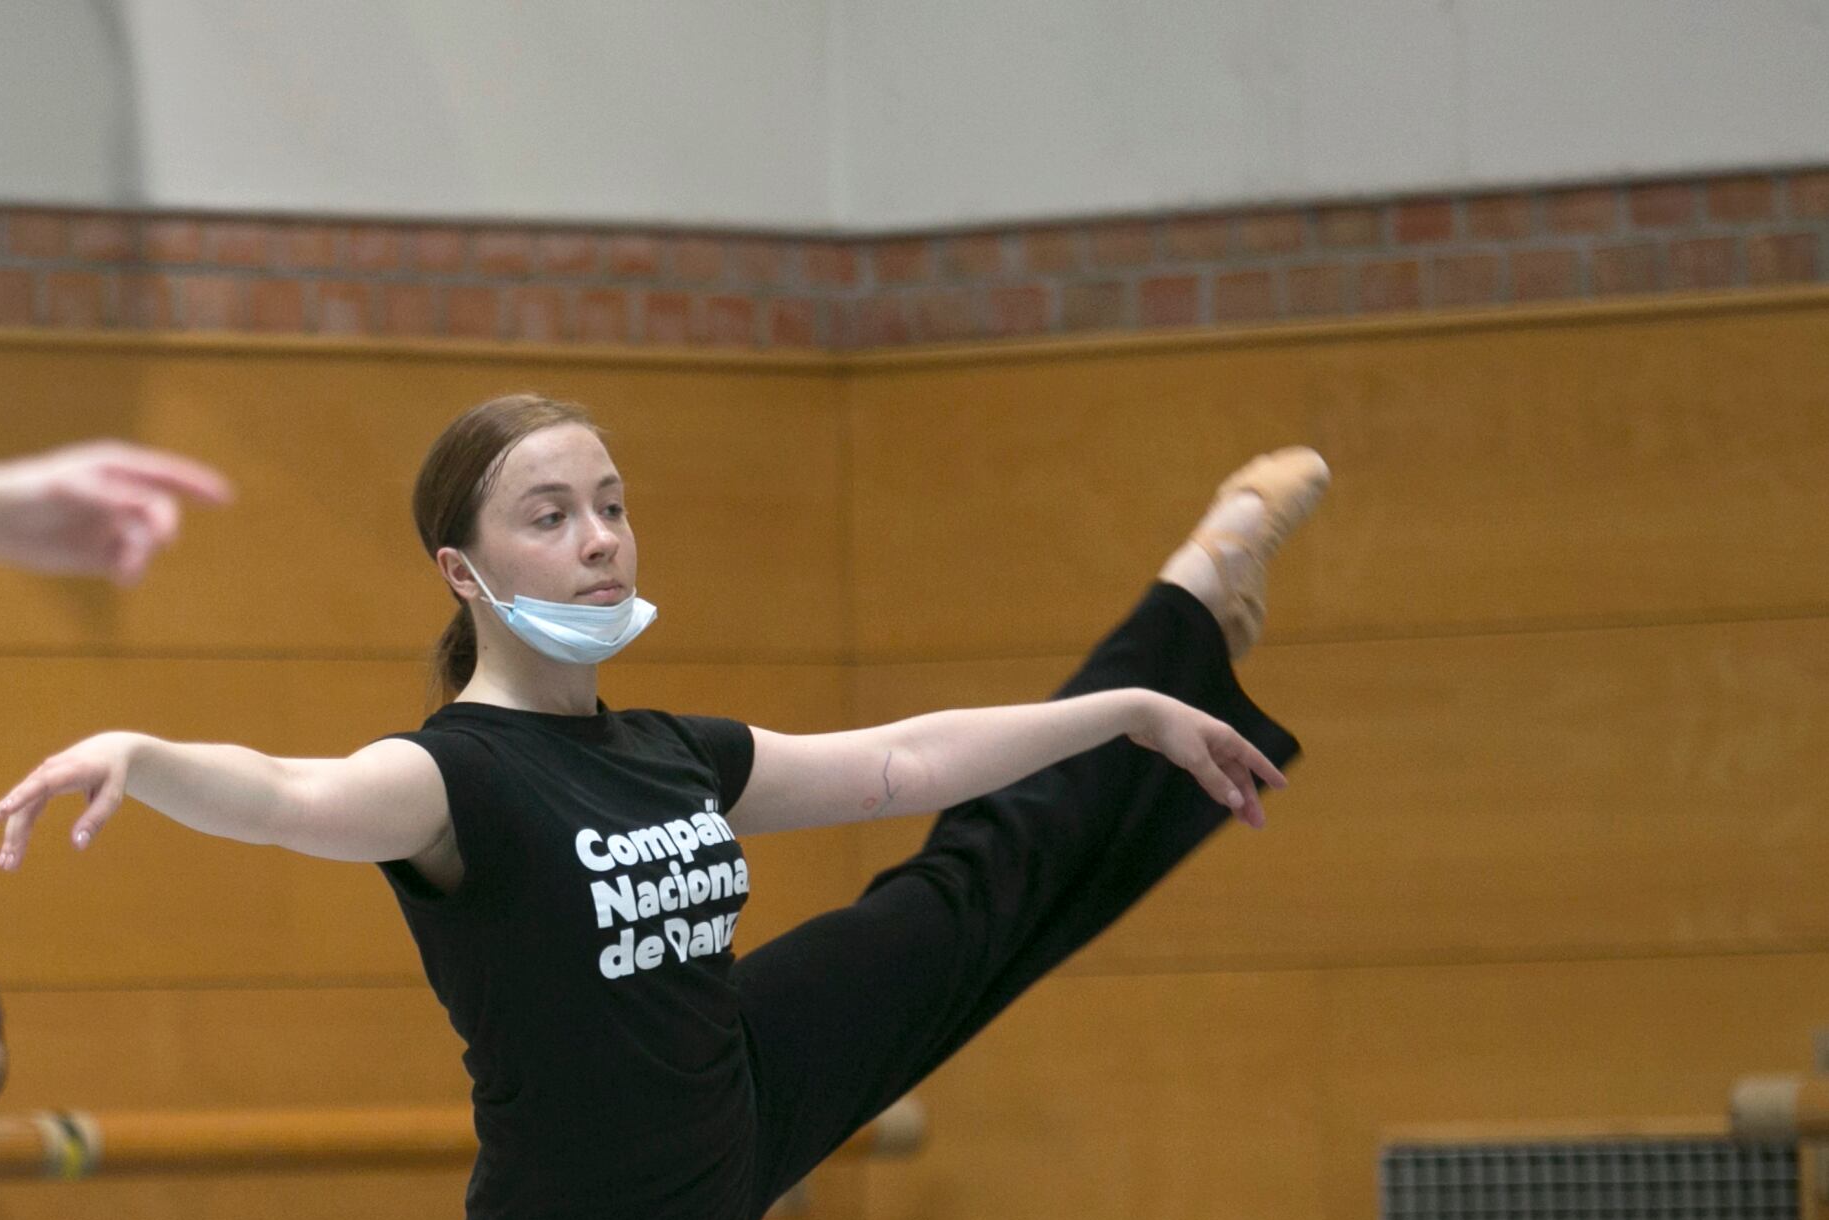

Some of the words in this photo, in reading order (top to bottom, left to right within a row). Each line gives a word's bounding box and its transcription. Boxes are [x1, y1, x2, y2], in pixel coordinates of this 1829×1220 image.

[575, 798, 736, 872] Compañ
[590, 858, 750, 929] Naciona
[599, 928, 666, 980] de
[664, 912, 739, 964] Danz
